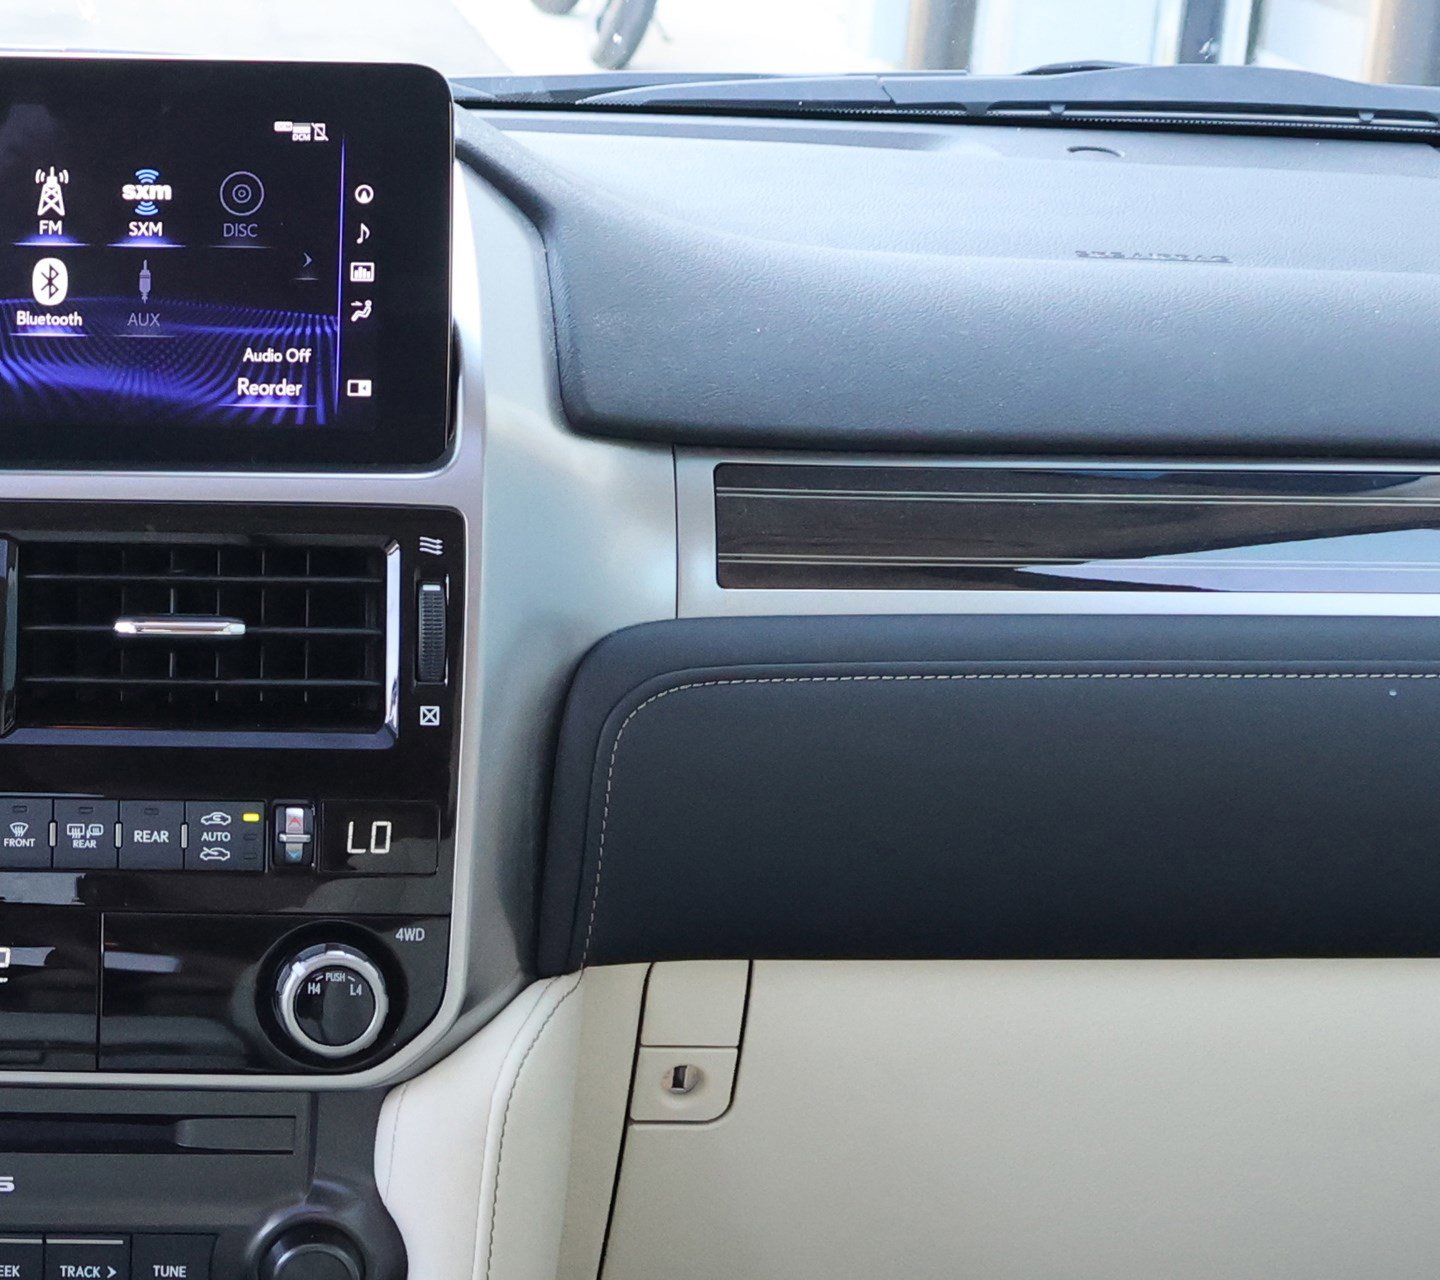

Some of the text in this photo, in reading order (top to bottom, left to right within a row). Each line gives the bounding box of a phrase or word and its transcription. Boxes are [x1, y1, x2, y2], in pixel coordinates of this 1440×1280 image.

[122, 184, 172, 201] sxm
[39, 220, 63, 235] FM
[128, 221, 163, 237] SXM
[222, 222, 259, 239] DISC
[16, 310, 83, 328] Bluetooth
[127, 312, 162, 328] AUX
[242, 347, 312, 364] Audio Off
[236, 379, 303, 397] Reorder
[2, 835, 36, 849] FRONT
[71, 837, 98, 849] REAR
[133, 829, 170, 845] REAR
[200, 830, 232, 844] AUTO
[346, 820, 392, 855] LO
[395, 927, 426, 942] 4WD
[325, 972, 346, 982] PUSH
[307, 983, 321, 995] H4
[349, 984, 362, 996] L4
[59, 1264, 103, 1280] TRACK
[152, 1263, 187, 1279] TUNE
